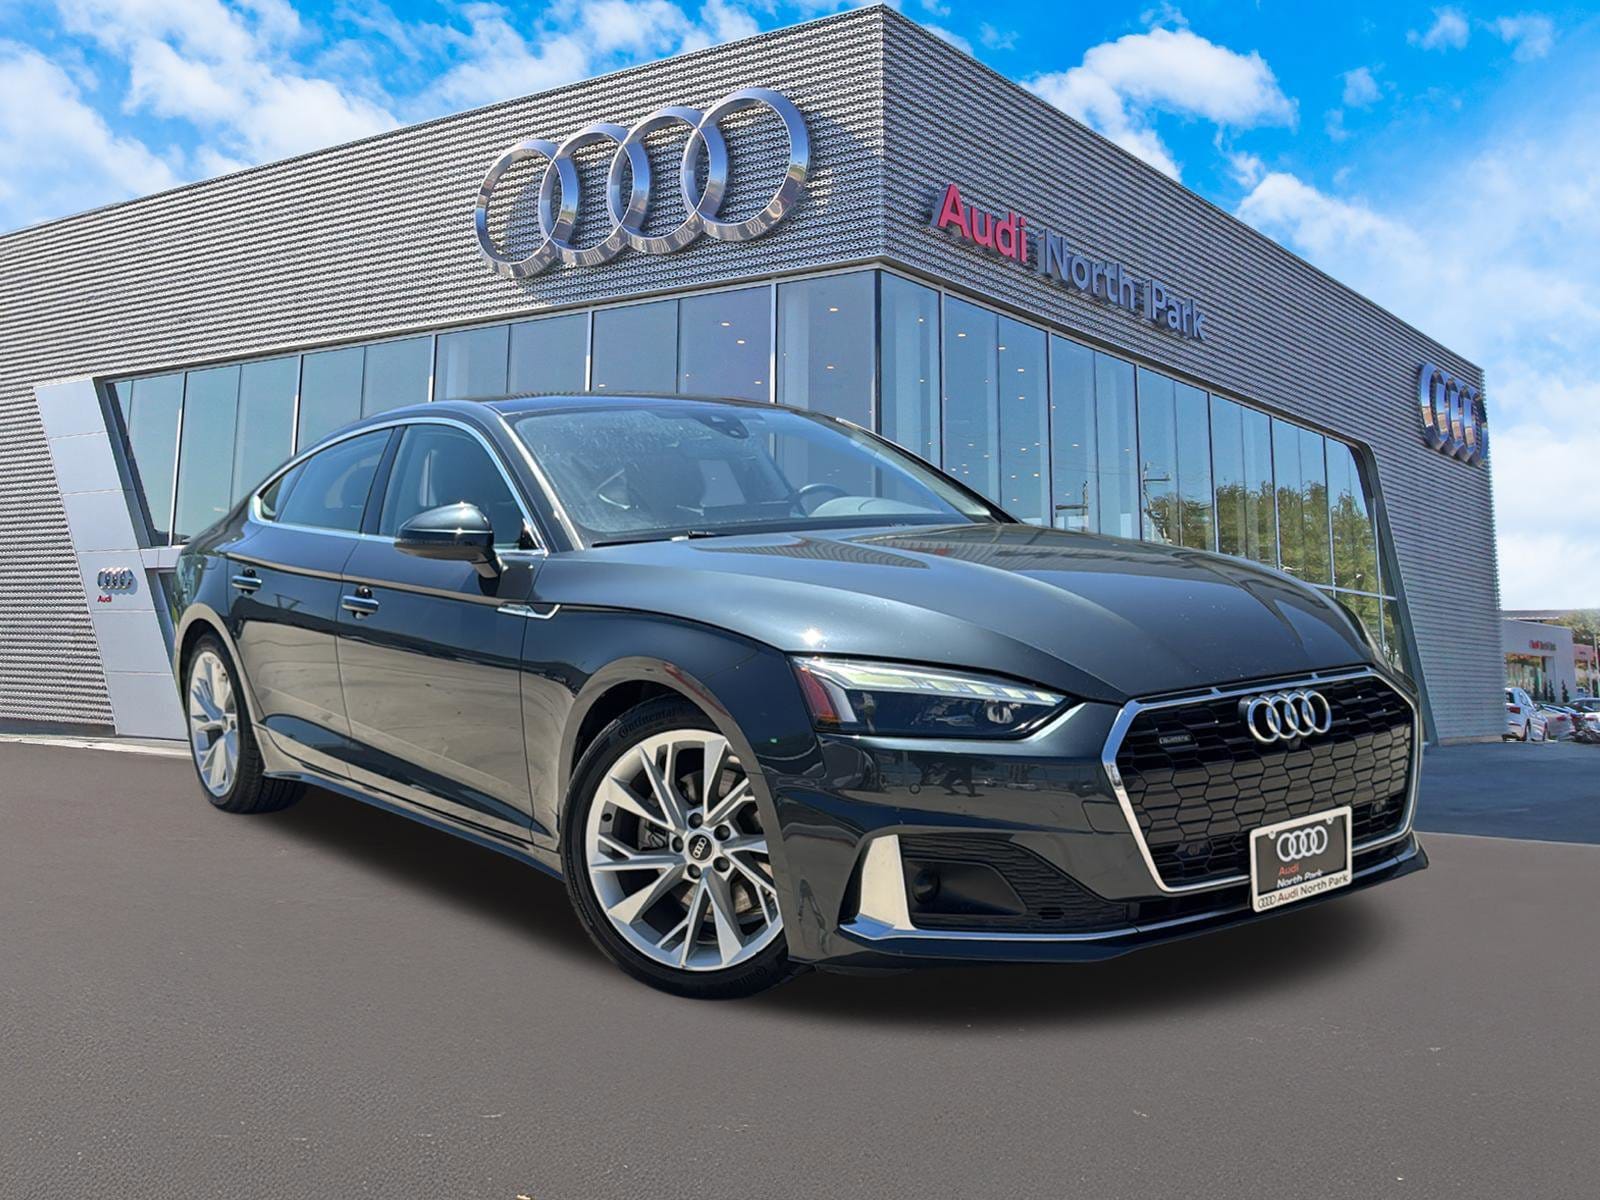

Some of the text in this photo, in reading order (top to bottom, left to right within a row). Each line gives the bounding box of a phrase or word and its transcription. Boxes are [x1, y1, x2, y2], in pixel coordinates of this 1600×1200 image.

[933, 183, 1208, 342] Audi North Park
[1278, 864, 1300, 875] Audi
[1276, 875, 1303, 888] North
[1277, 875, 1349, 902] Audi North Park
